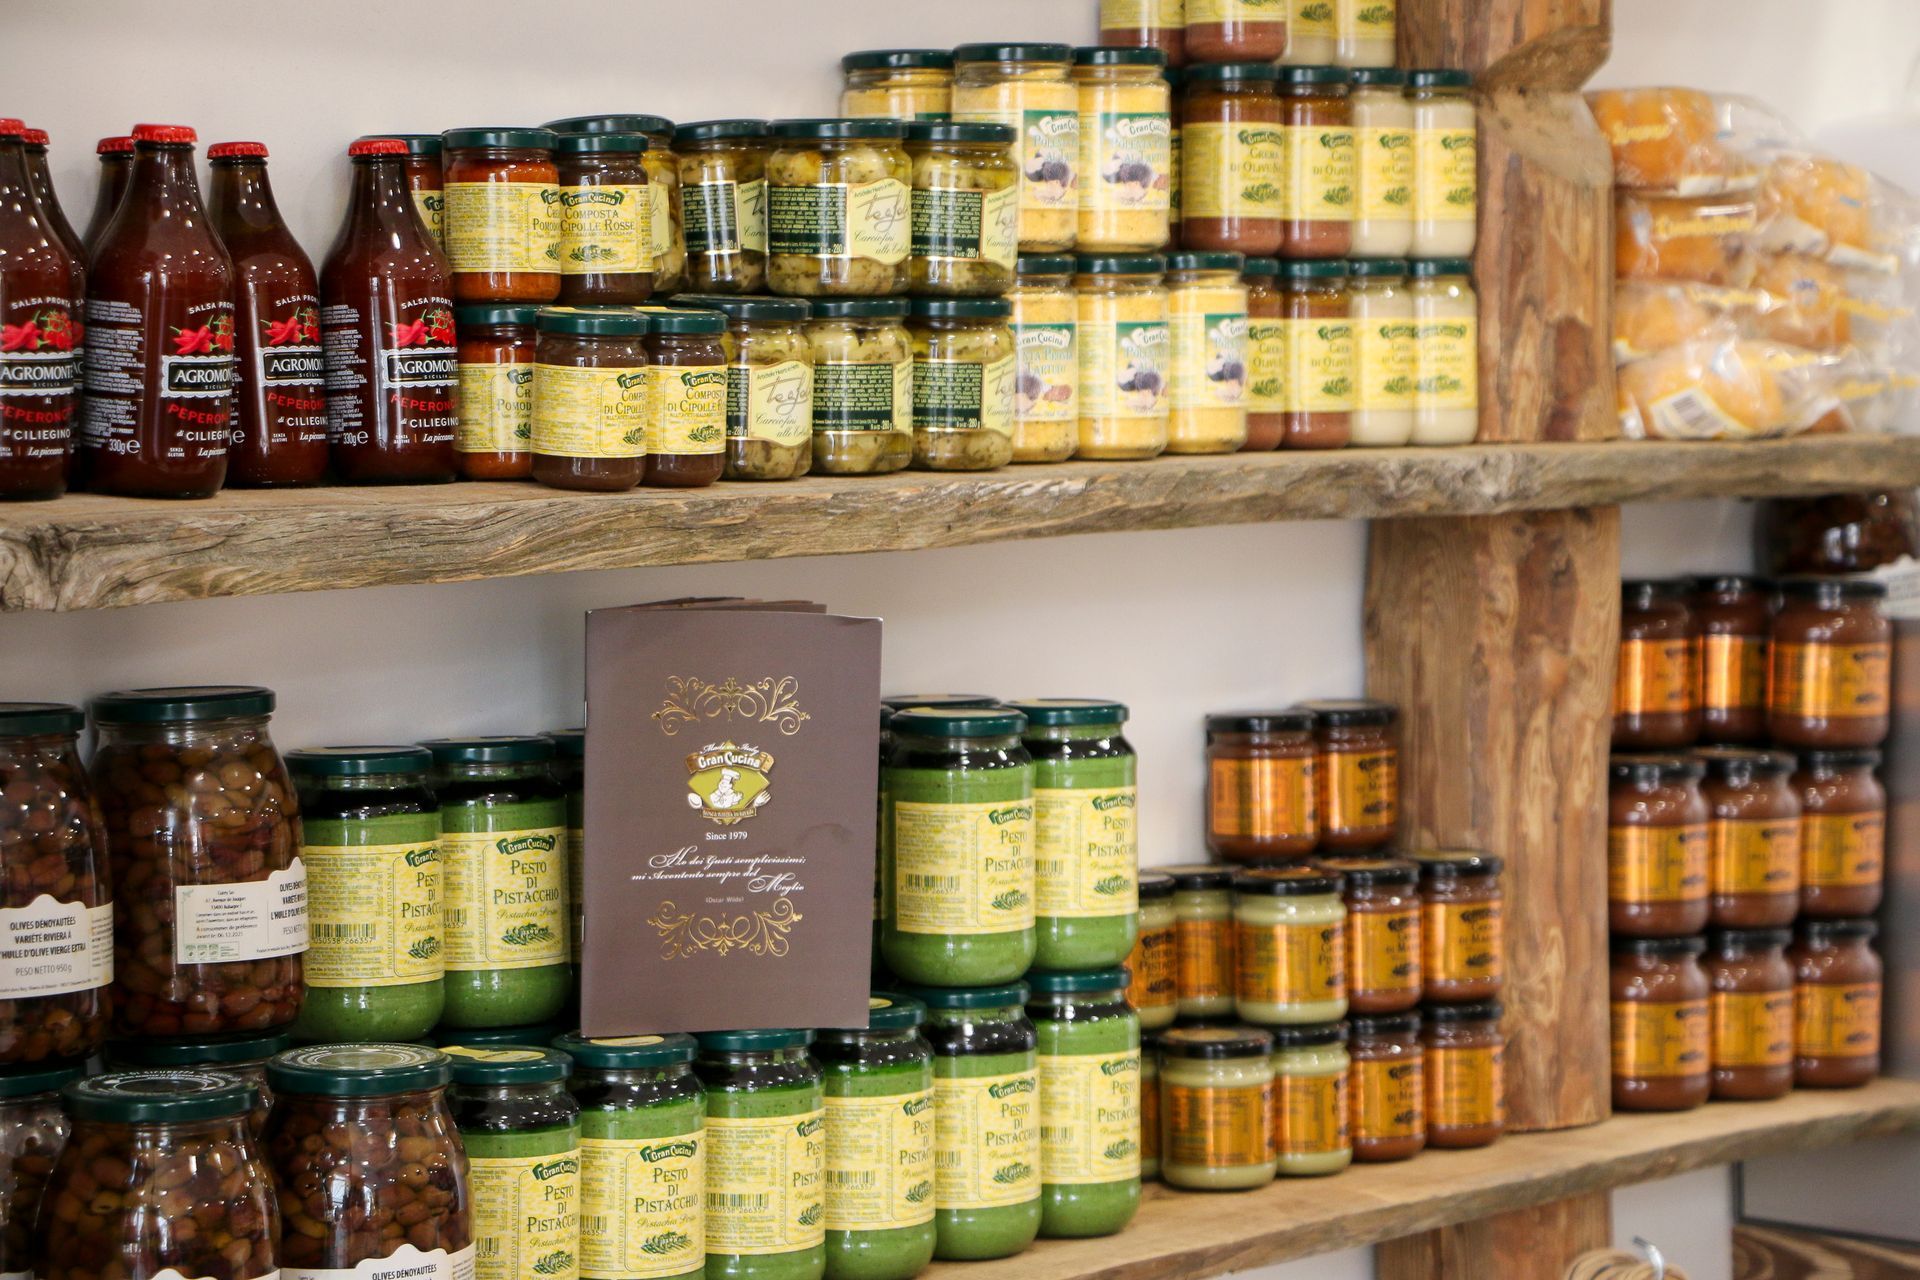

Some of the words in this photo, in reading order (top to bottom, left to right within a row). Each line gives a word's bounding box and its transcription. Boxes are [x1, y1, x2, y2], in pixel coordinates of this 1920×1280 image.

[565, 207, 620, 220] COMPOSTA
[604, 219, 636, 231] ROSSE
[11, 297, 43, 310] SALSA
[276, 295, 302, 307] SALSA
[401, 297, 429, 310] SALSA
[188, 301, 217, 315] SALSA
[604, 405, 614, 414] DI
[667, 403, 677, 413] DI
[410, 416, 460, 429] CILIEGINO
[14, 428, 71, 442] CILIEGINO
[706, 832, 727, 840] Since
[729, 831, 748, 840] 1979
[1013, 845, 1021, 858] DI
[511, 859, 548, 876] PESTO
[689, 857, 705, 865] dei
[704, 854, 733, 871] Gusti
[648, 870, 705, 881] Accontento
[706, 871, 742, 885] sempre
[743, 866, 761, 878] del
[526, 877, 538, 889] DI
[429, 889, 436, 901] DI
[493, 888, 560, 906] PISTACCHIO
[10, 920, 35, 932] OLIVES
[44, 931, 67, 942] RIVIERA
[24, 947, 50, 959] D'OLIVE
[50, 944, 71, 955] VIERGE
[15, 967, 34, 977] PESO
[34, 964, 56, 975] NETTO
[1001, 1103, 1031, 1118] PESTO
[1014, 1118, 1023, 1130] DI
[654, 1167, 689, 1184] PESTO
[545, 1184, 575, 1201] PESTO
[667, 1184, 679, 1197] DI
[557, 1201, 567, 1215] DI
[635, 1194, 699, 1213] PISTACCHIO
